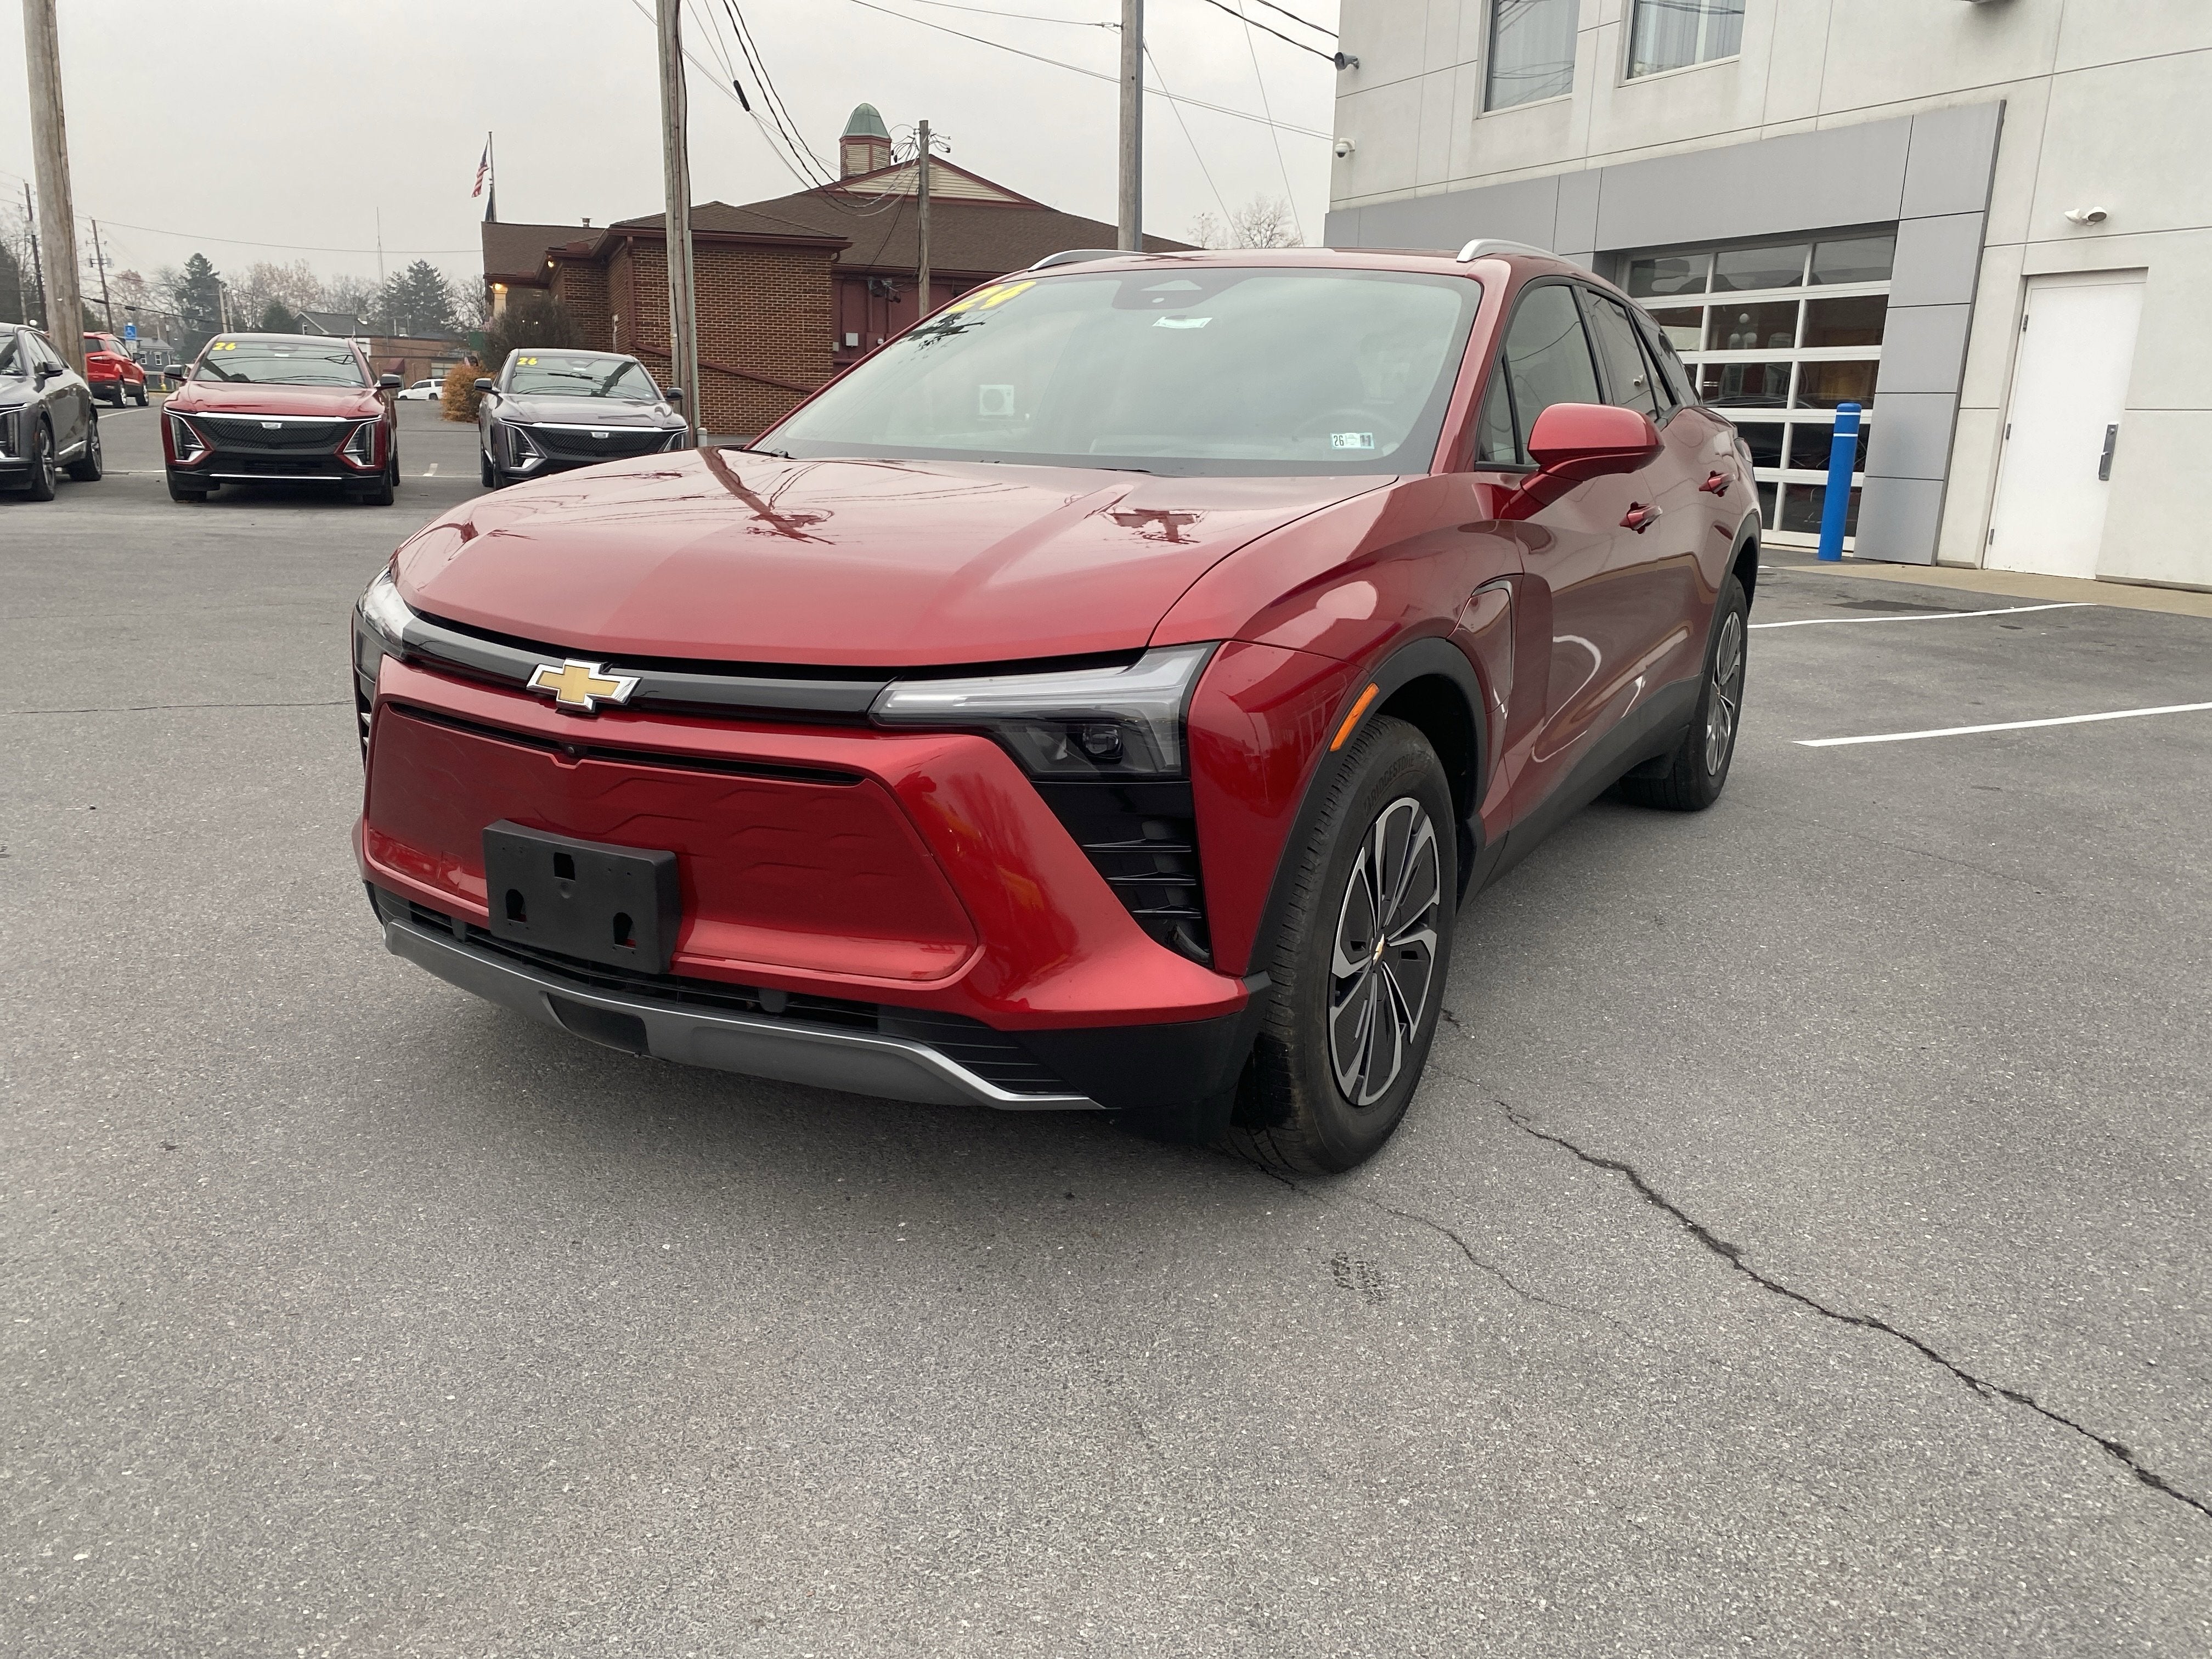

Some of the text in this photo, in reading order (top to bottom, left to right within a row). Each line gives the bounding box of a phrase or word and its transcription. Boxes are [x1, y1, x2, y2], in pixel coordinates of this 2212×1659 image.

[212, 342, 236, 351] 26
[517, 357, 537, 365] 26
[1333, 435, 1344, 446] 26
